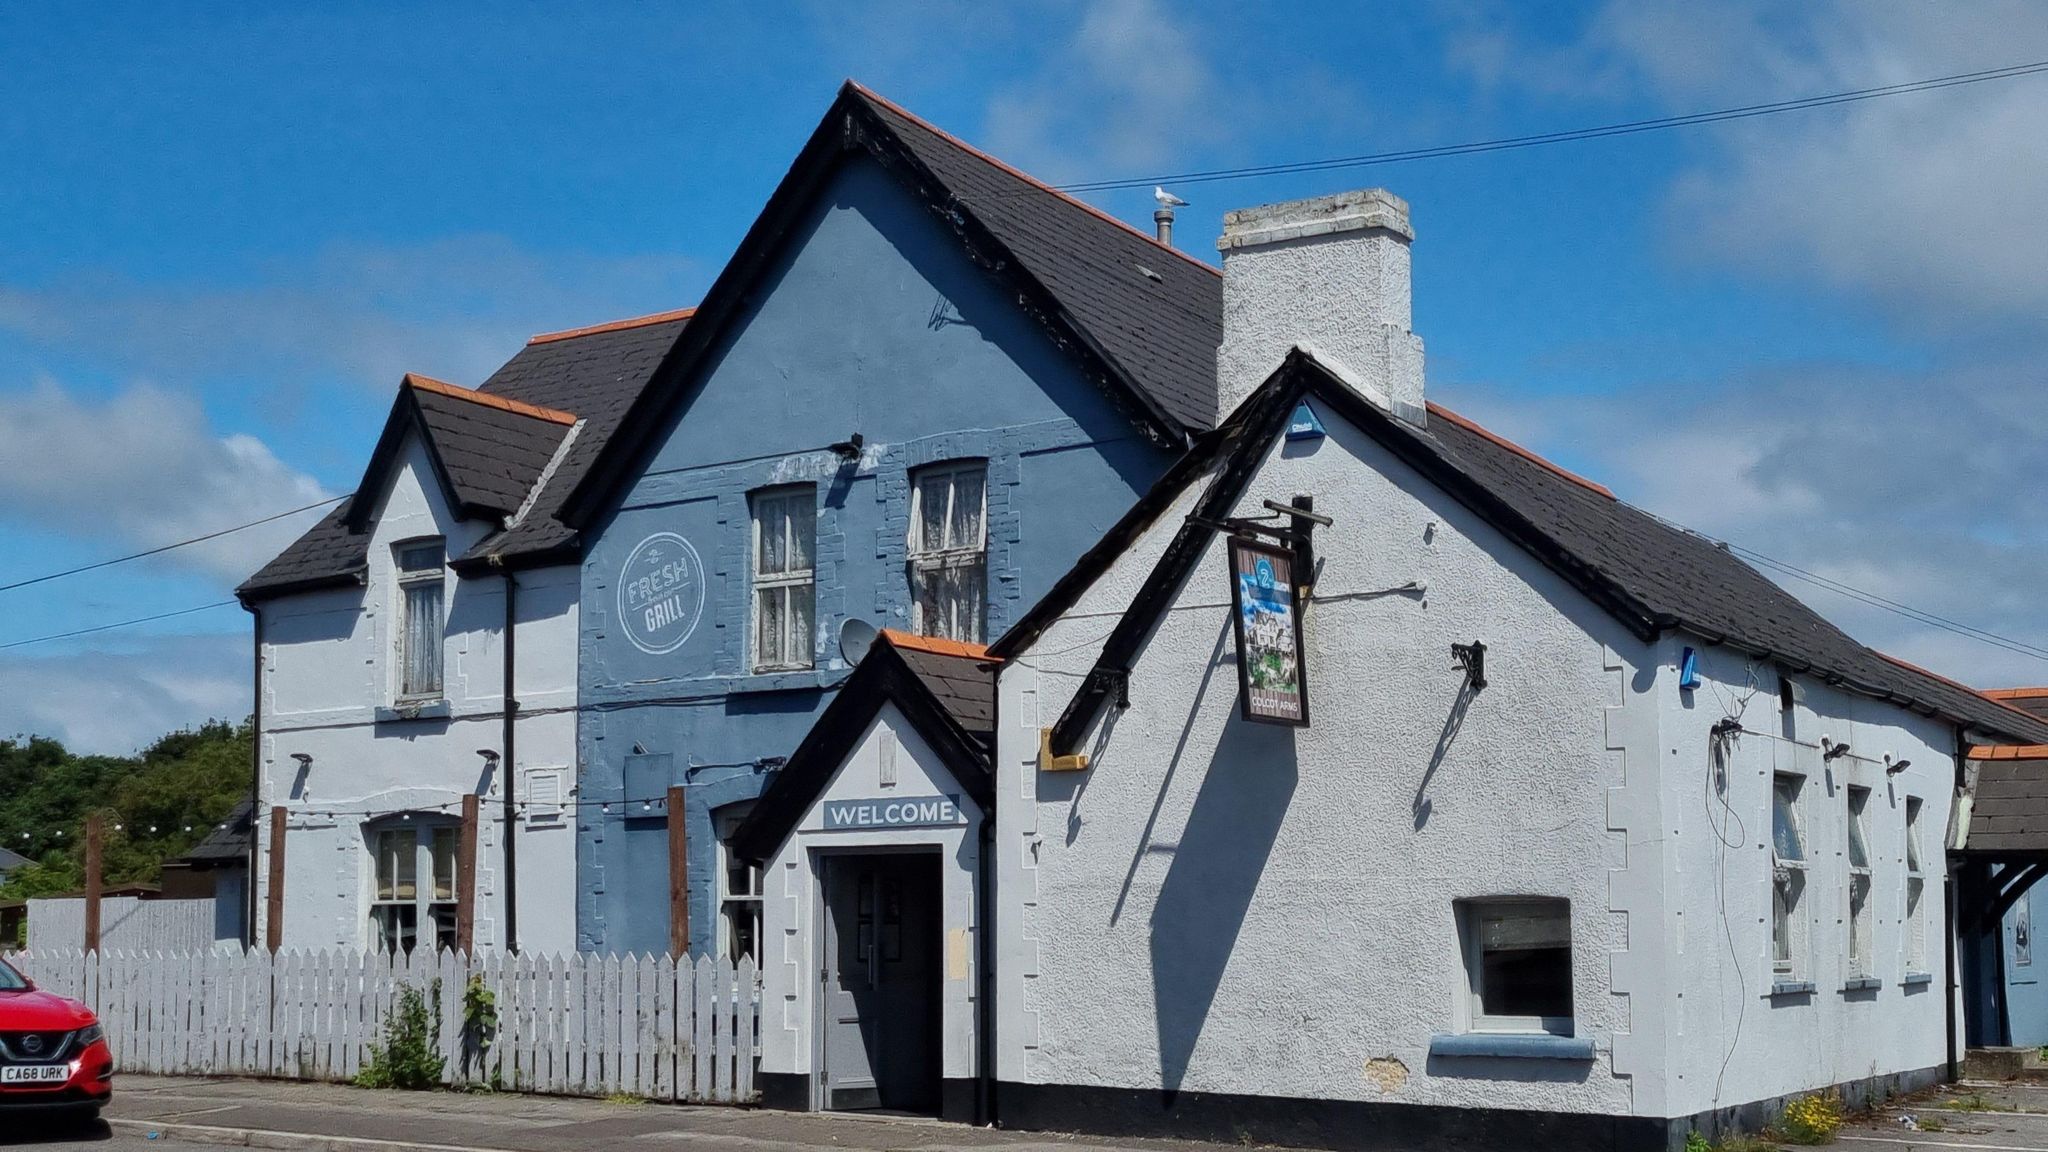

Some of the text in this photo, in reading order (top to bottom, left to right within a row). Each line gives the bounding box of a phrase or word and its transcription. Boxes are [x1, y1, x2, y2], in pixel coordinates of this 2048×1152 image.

[628, 557, 689, 604] FRESH
[645, 594, 685, 632] GRILL
[1252, 696, 1298, 712] COLCOT ARMS
[831, 801, 954, 825] WELCOME
[7, 1067, 63, 1080] CA68 URK
